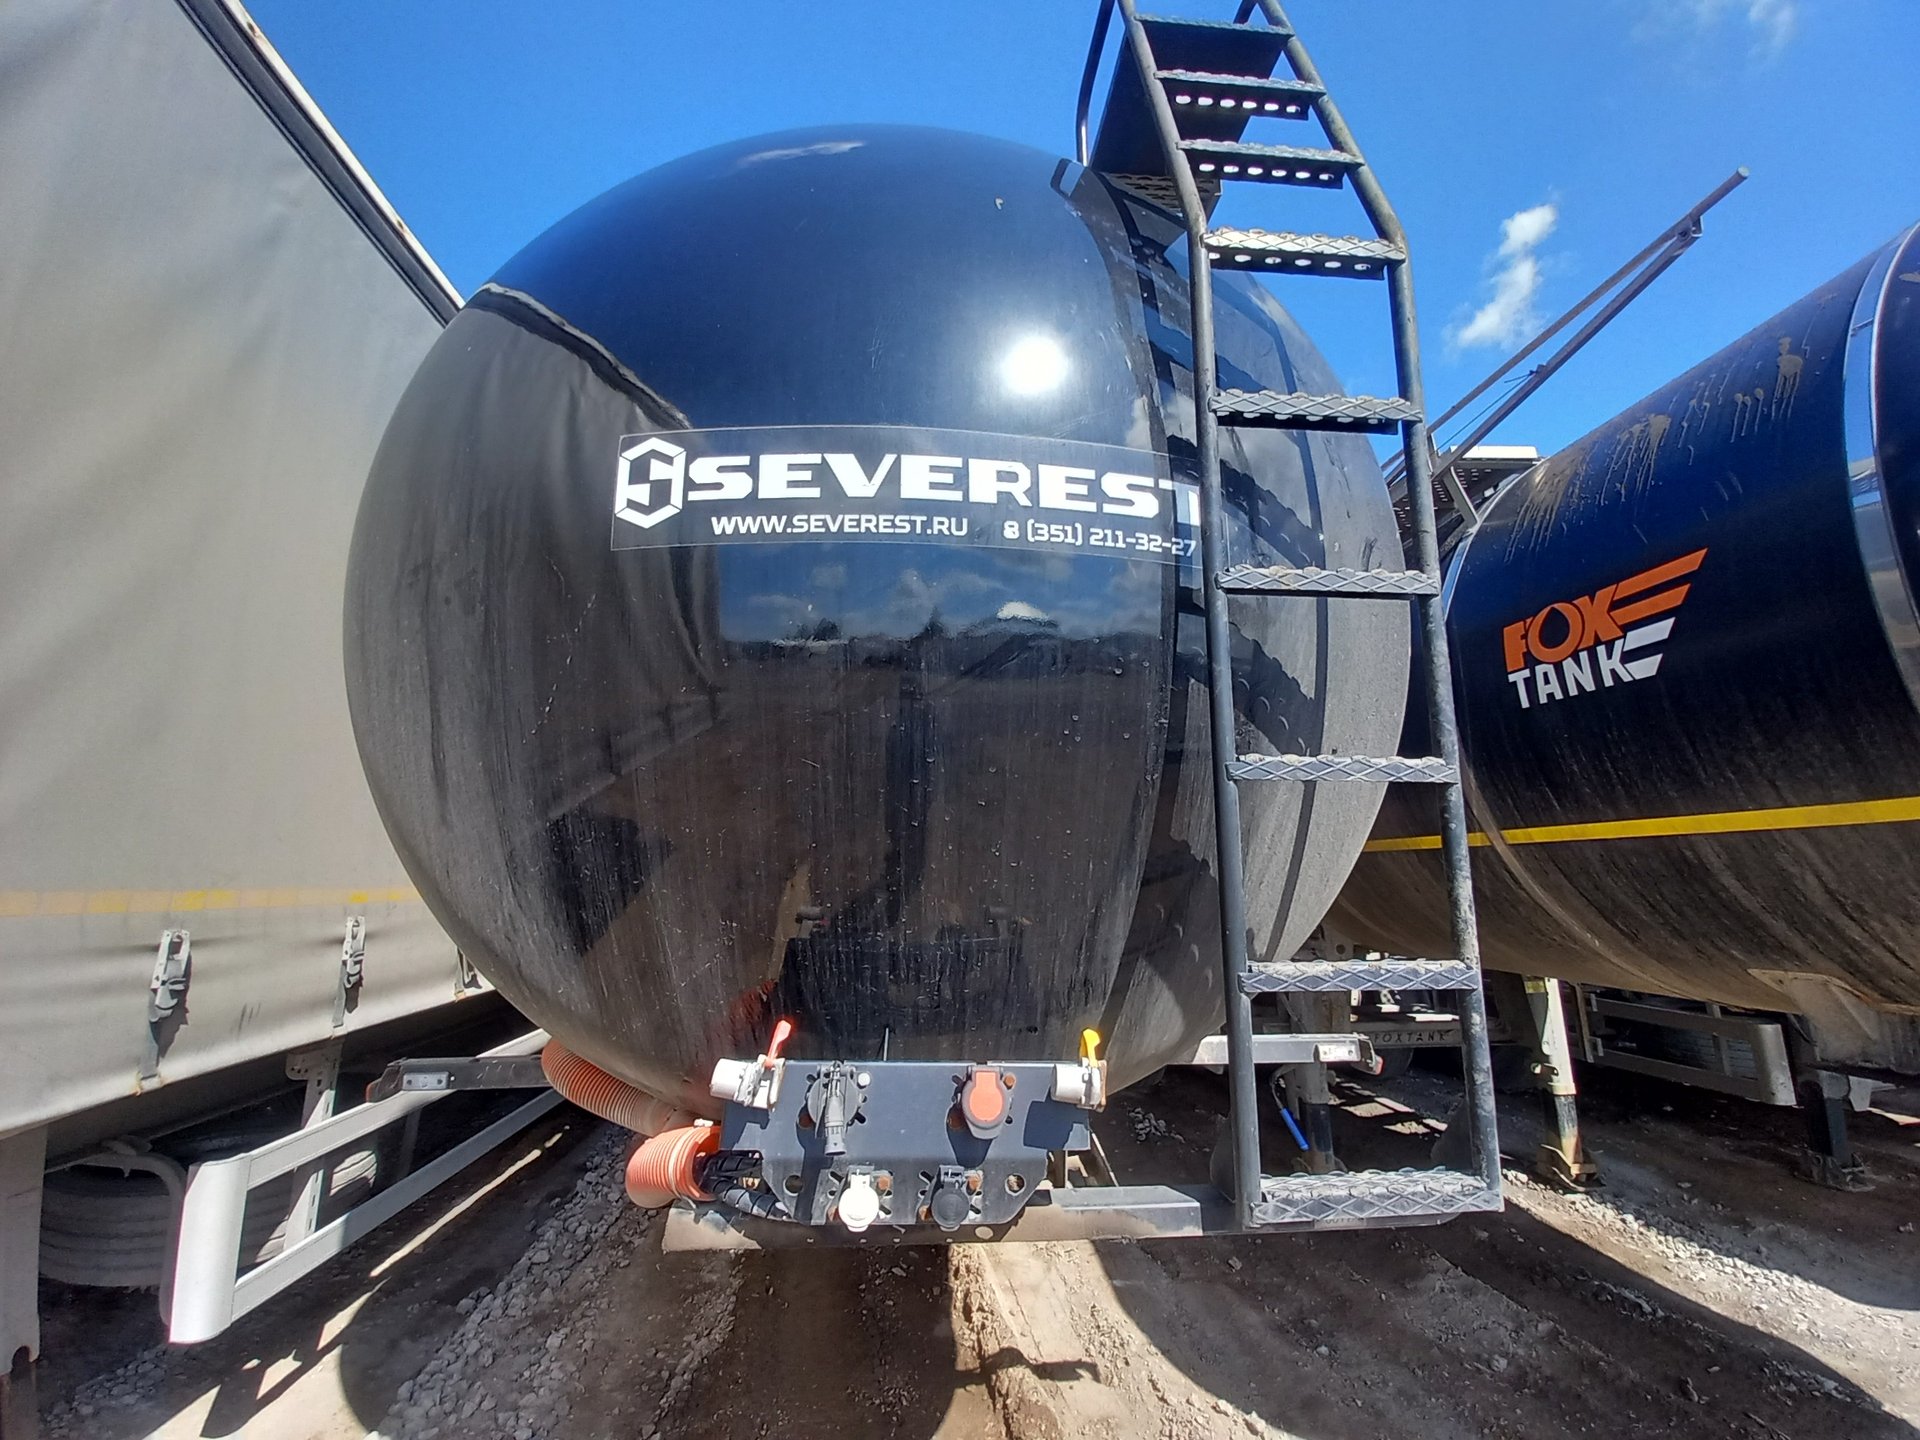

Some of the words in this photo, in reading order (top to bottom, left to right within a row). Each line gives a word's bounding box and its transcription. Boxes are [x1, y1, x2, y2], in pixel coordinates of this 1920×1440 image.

[687, 452, 1200, 526] SEVEREST
[711, 514, 969, 536] WWW.SEVEREST.RU
[1003, 520, 1020, 540] 8
[1026, 518, 1083, 546] (351)
[1089, 527, 1197, 557] 211-32-27
[1507, 637, 1634, 709] TANK
